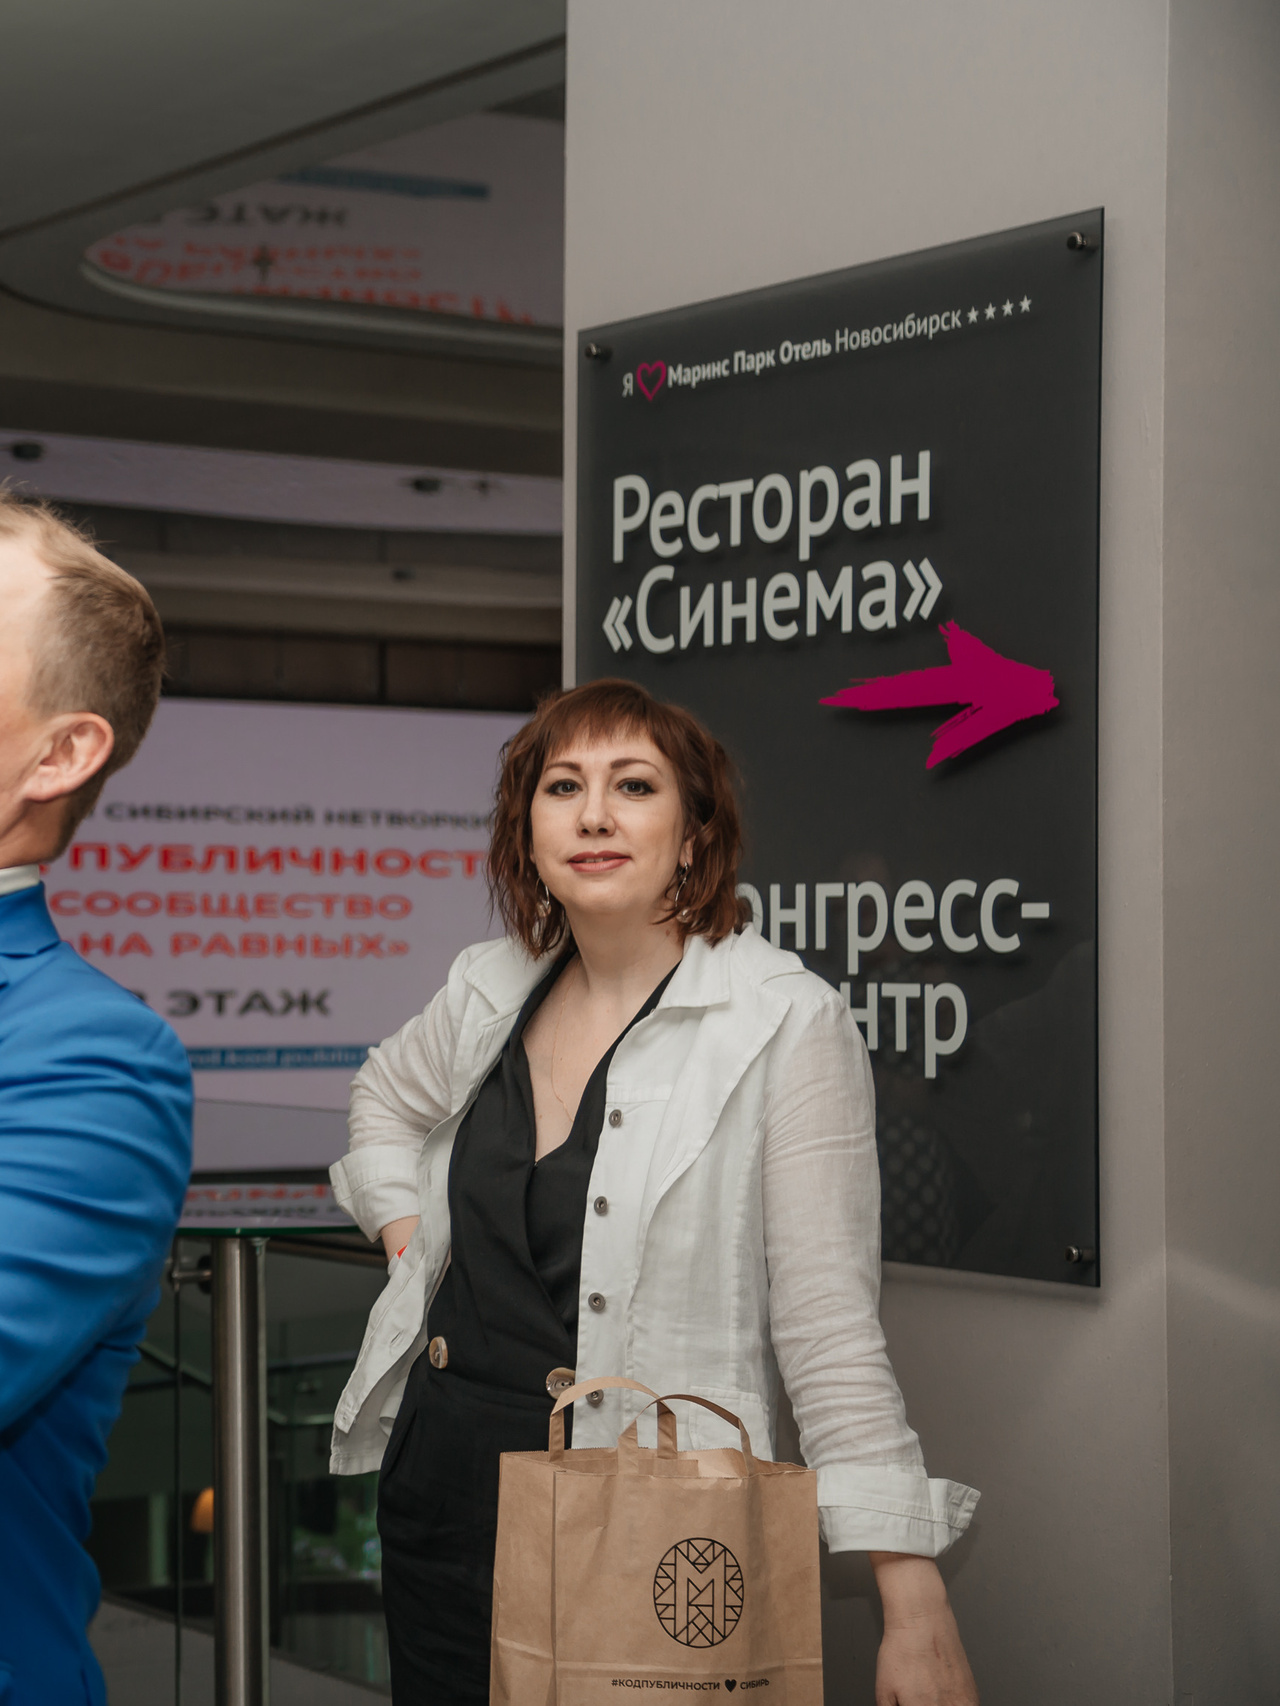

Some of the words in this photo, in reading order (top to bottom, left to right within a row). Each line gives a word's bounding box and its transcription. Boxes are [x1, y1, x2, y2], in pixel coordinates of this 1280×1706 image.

[622, 372, 634, 398] Я
[667, 359, 730, 390] Маринс
[733, 348, 776, 376] Парк
[779, 336, 832, 365] Отель
[834, 308, 962, 354] Новосибирск
[612, 450, 931, 564] Ресторан
[602, 557, 943, 654] «Синема»
[70, 841, 488, 880] ПУБЛИЧНОСТ
[49, 889, 412, 922] СООБЩЕСТВО
[734, 878, 1050, 975] онгресс-
[65, 931, 154, 958] НА
[167, 988, 333, 1019] ЭТАЖ
[840, 981, 968, 1079] нтр
[611, 1678, 720, 1691] #КОДПУБЛИЧНОСТИ
[740, 1677, 770, 1690] СИБИРЬ
